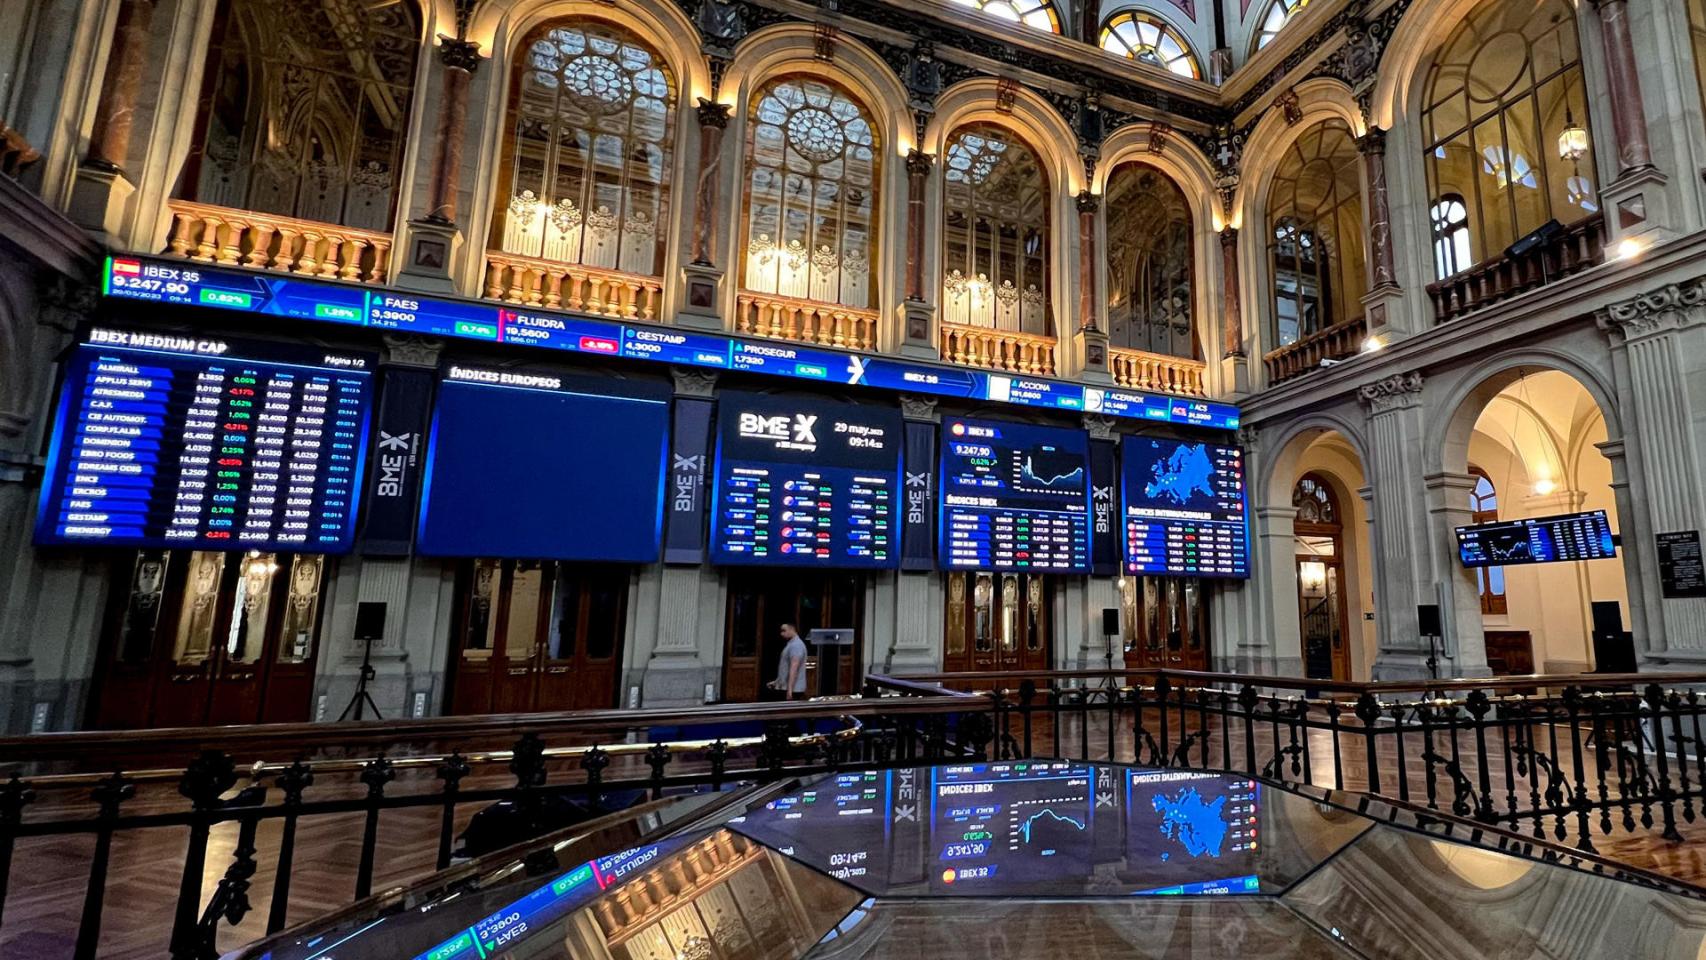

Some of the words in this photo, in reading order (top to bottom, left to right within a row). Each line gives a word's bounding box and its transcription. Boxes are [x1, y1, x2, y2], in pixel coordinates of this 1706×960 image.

[144, 266, 179, 280] IBEX
[182, 271, 199, 282] 35
[113, 275, 189, 294] 9.247,90
[385, 298, 419, 311] FAES
[371, 309, 416, 322] 3,3900
[517, 315, 566, 330] FLUIDRA
[90, 329, 128, 344] IBEX
[130, 333, 195, 351] MEDIUM
[197, 341, 228, 354] CAP
[636, 331, 686, 344] GESTAMP
[625, 342, 661, 352] 4,3000
[744, 345, 797, 359] PROSEGUR
[97, 363, 139, 374] ALMIRALL
[352, 359, 366, 367] 1/2
[95, 376, 127, 386] APPLUS
[450, 366, 499, 382] ÍNDICES
[500, 373, 561, 388] EUROPEOS
[1018, 381, 1051, 391] ACCIONA
[1194, 404, 1208, 412] ACS
[104, 414, 148, 424] AUTOMOT.
[740, 413, 790, 435] BME
[835, 422, 847, 432] 29
[83, 437, 131, 447] DOMINION
[105, 452, 136, 460] FOODS
[956, 444, 990, 456] 9.247,90
[78, 463, 118, 473] EDREAMS
[377, 454, 402, 496] BME
[675, 474, 692, 511] BME
[70, 501, 92, 509] FAES
[908, 490, 922, 523] BME
[68, 513, 109, 522] GESTAMP
[1095, 502, 1107, 533] BME
